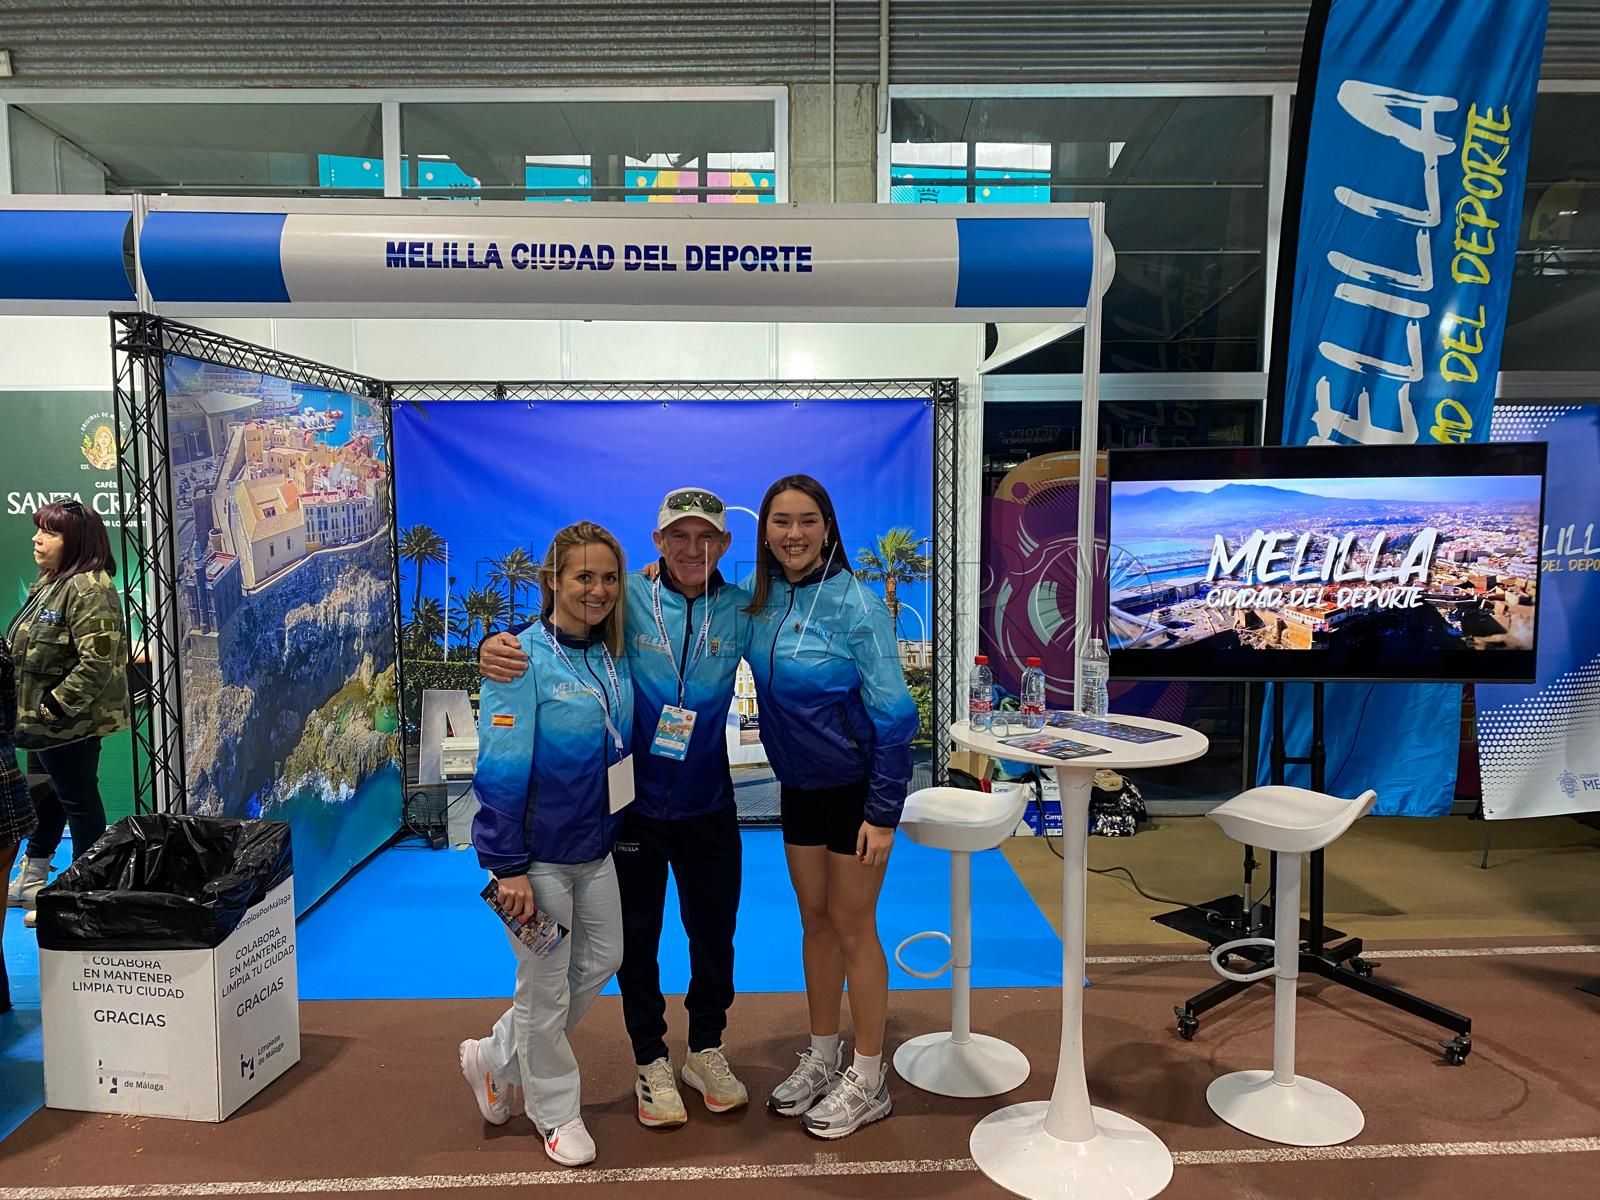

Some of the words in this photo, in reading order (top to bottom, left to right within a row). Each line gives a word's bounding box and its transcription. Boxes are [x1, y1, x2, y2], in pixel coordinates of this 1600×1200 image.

[1451, 102, 1513, 285] DEPORTE
[385, 241, 503, 269] MELILLA
[511, 243, 614, 271] CIUDAD
[624, 245, 677, 272] DEL
[685, 245, 812, 273] DEPORTE
[1307, 79, 1458, 445] ELILLA
[1439, 304, 1487, 384] DEL
[1542, 523, 1600, 556] LILL
[1206, 527, 1437, 586] MELILLA
[1568, 558, 1600, 571] DEPO
[1206, 588, 1283, 609] CIUDAD
[1287, 587, 1328, 608] DEL
[1334, 586, 1425, 610] DEPORTE
[1583, 779, 1600, 791] ME
[1044, 813, 1062, 822] Camp
[229, 964, 241, 978] EN
[243, 935, 287, 970] MANTENER
[236, 926, 281, 960] COLABORA
[83, 968, 100, 979] EN
[104, 970, 172, 984] MANTENER
[92, 956, 162, 970] COLABORA
[222, 972, 251, 998] LIMPIA
[252, 963, 263, 977] TU
[264, 944, 295, 970] CIUDAD
[72, 981, 115, 993] LIMPIA
[117, 984, 133, 995] TU
[136, 986, 184, 999] CIUDAD
[237, 976, 284, 1017] GRACIAS
[94, 1009, 166, 1027] GRACIAS
[124, 1080, 134, 1088] de
[136, 1081, 164, 1091] Málaga
